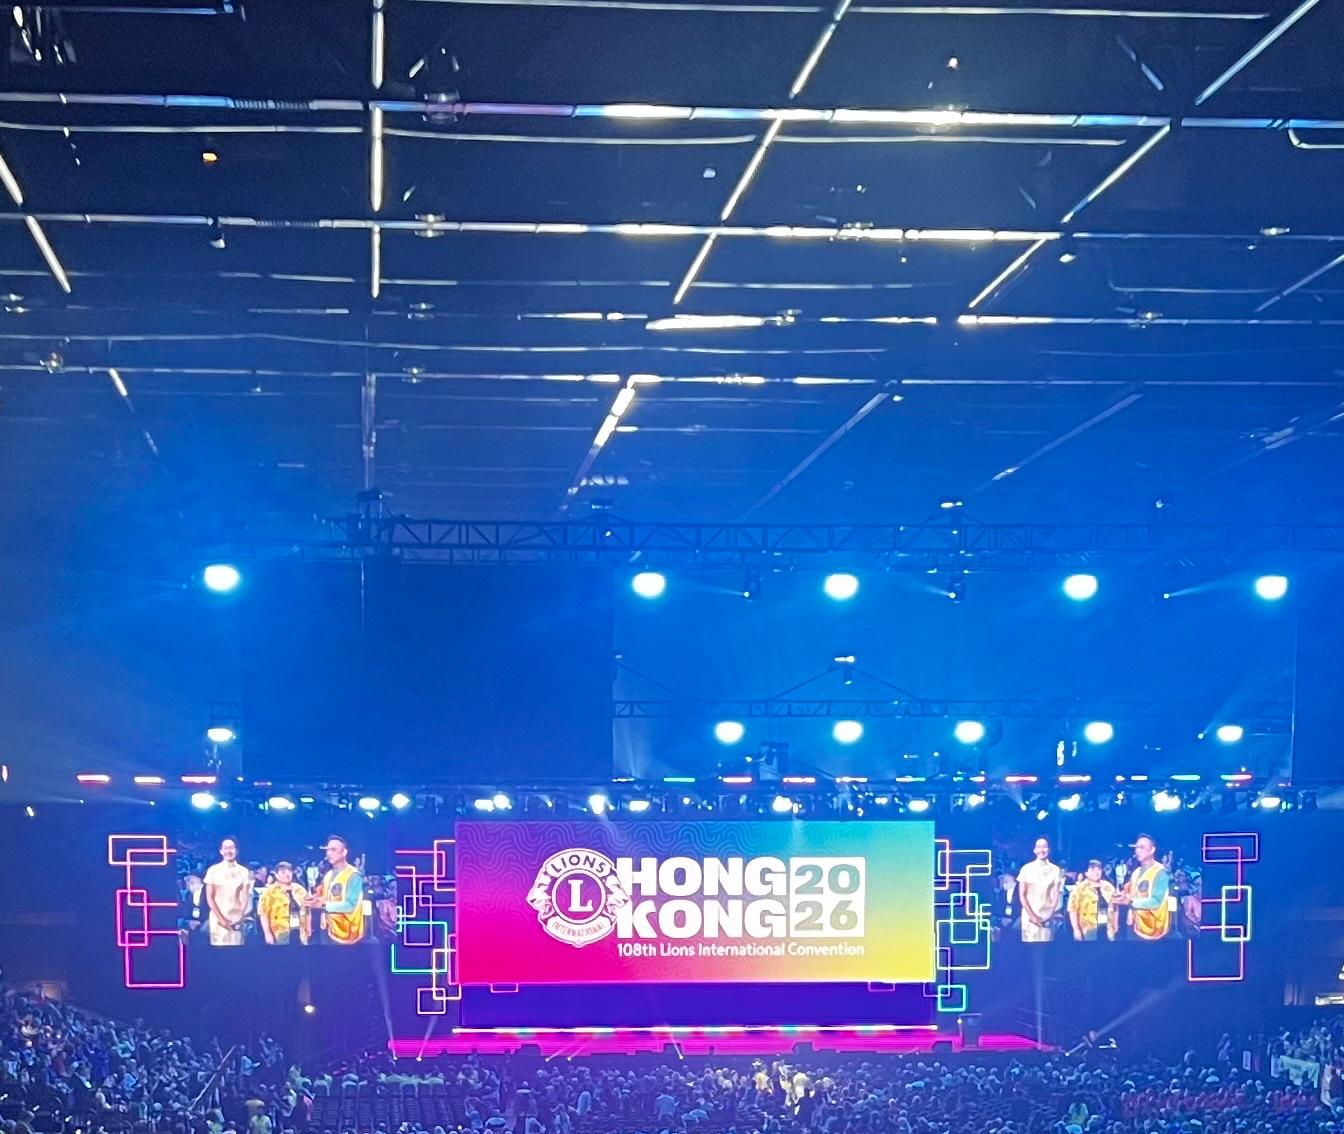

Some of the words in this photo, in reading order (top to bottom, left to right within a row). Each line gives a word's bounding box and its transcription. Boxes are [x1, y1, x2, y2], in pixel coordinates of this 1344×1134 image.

[550, 853, 607, 874] LIONS
[617, 856, 787, 896] HONG
[794, 863, 861, 895] 20
[567, 879, 594, 912] L
[617, 899, 787, 939] KONG
[794, 900, 858, 931] 26
[617, 942, 657, 957] 108th
[659, 942, 696, 957] Lions
[698, 942, 785, 957] International
[787, 942, 865, 957] Convention
